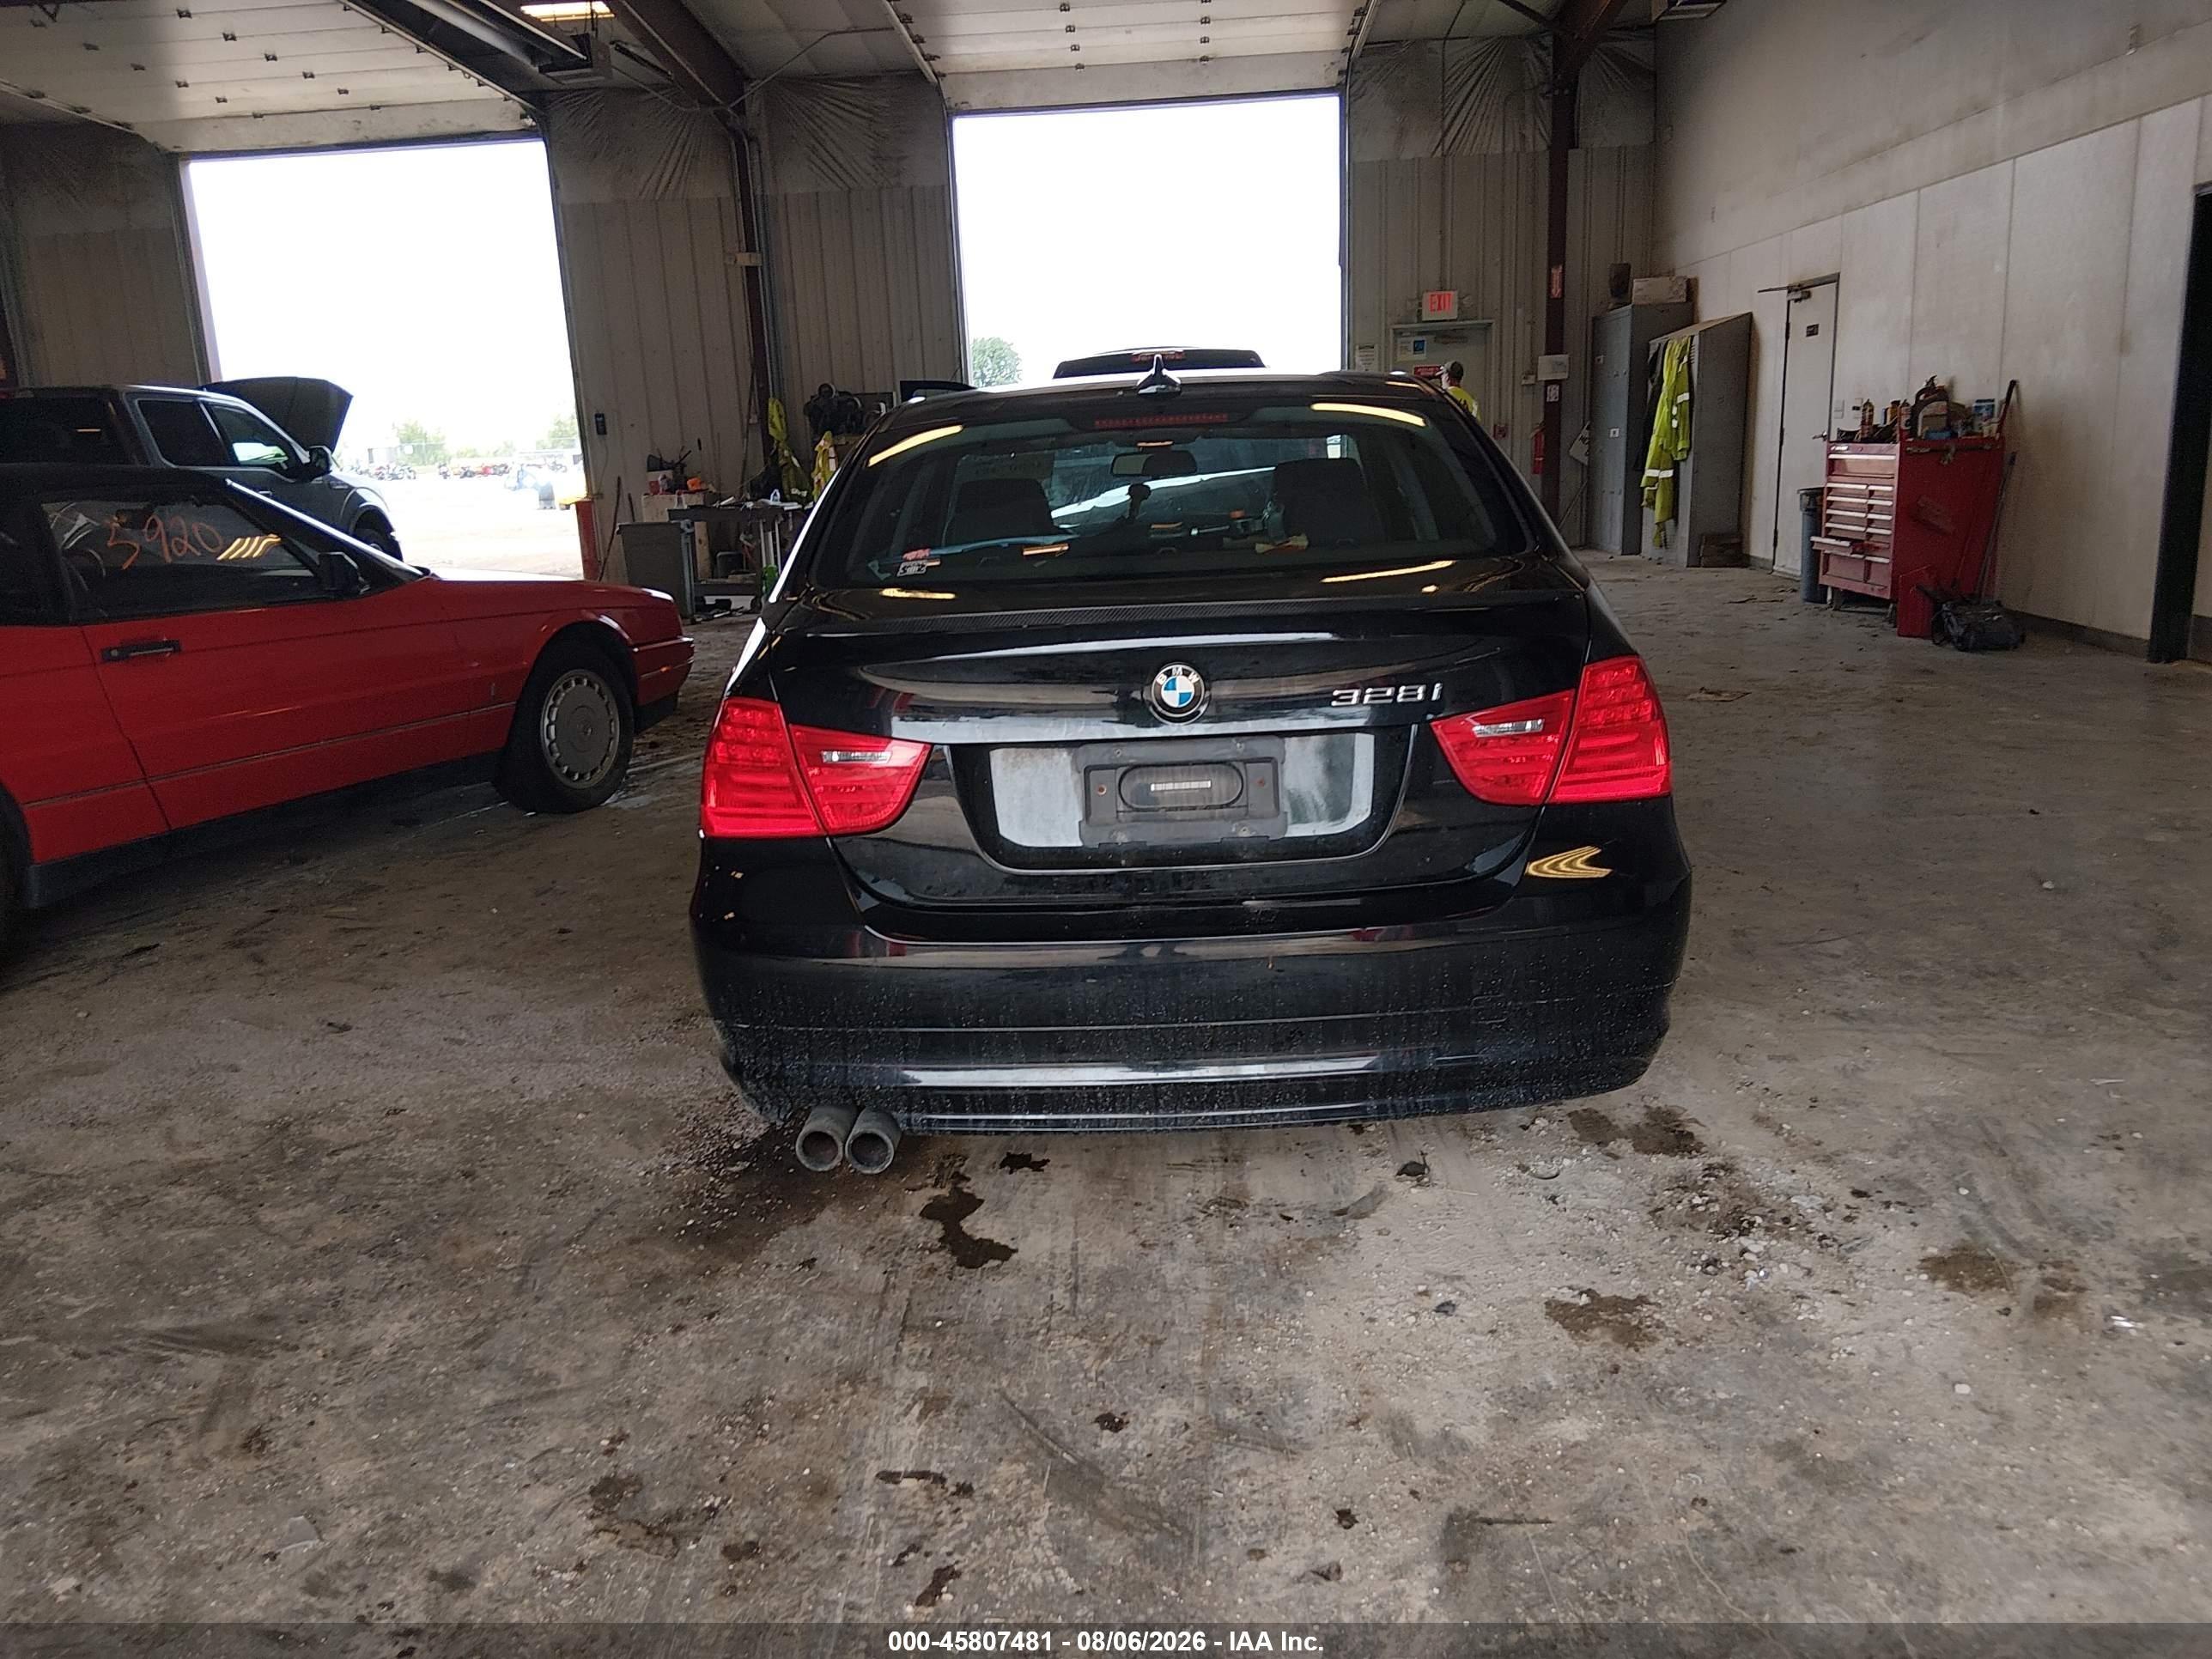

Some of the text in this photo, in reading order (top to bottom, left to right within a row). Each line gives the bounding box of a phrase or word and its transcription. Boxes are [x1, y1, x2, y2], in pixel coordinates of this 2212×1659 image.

[1429, 292, 1453, 313] EXIT
[105, 512, 223, 570] 5920
[1156, 666, 1200, 685] BMW
[1331, 683, 1443, 707] 328i
